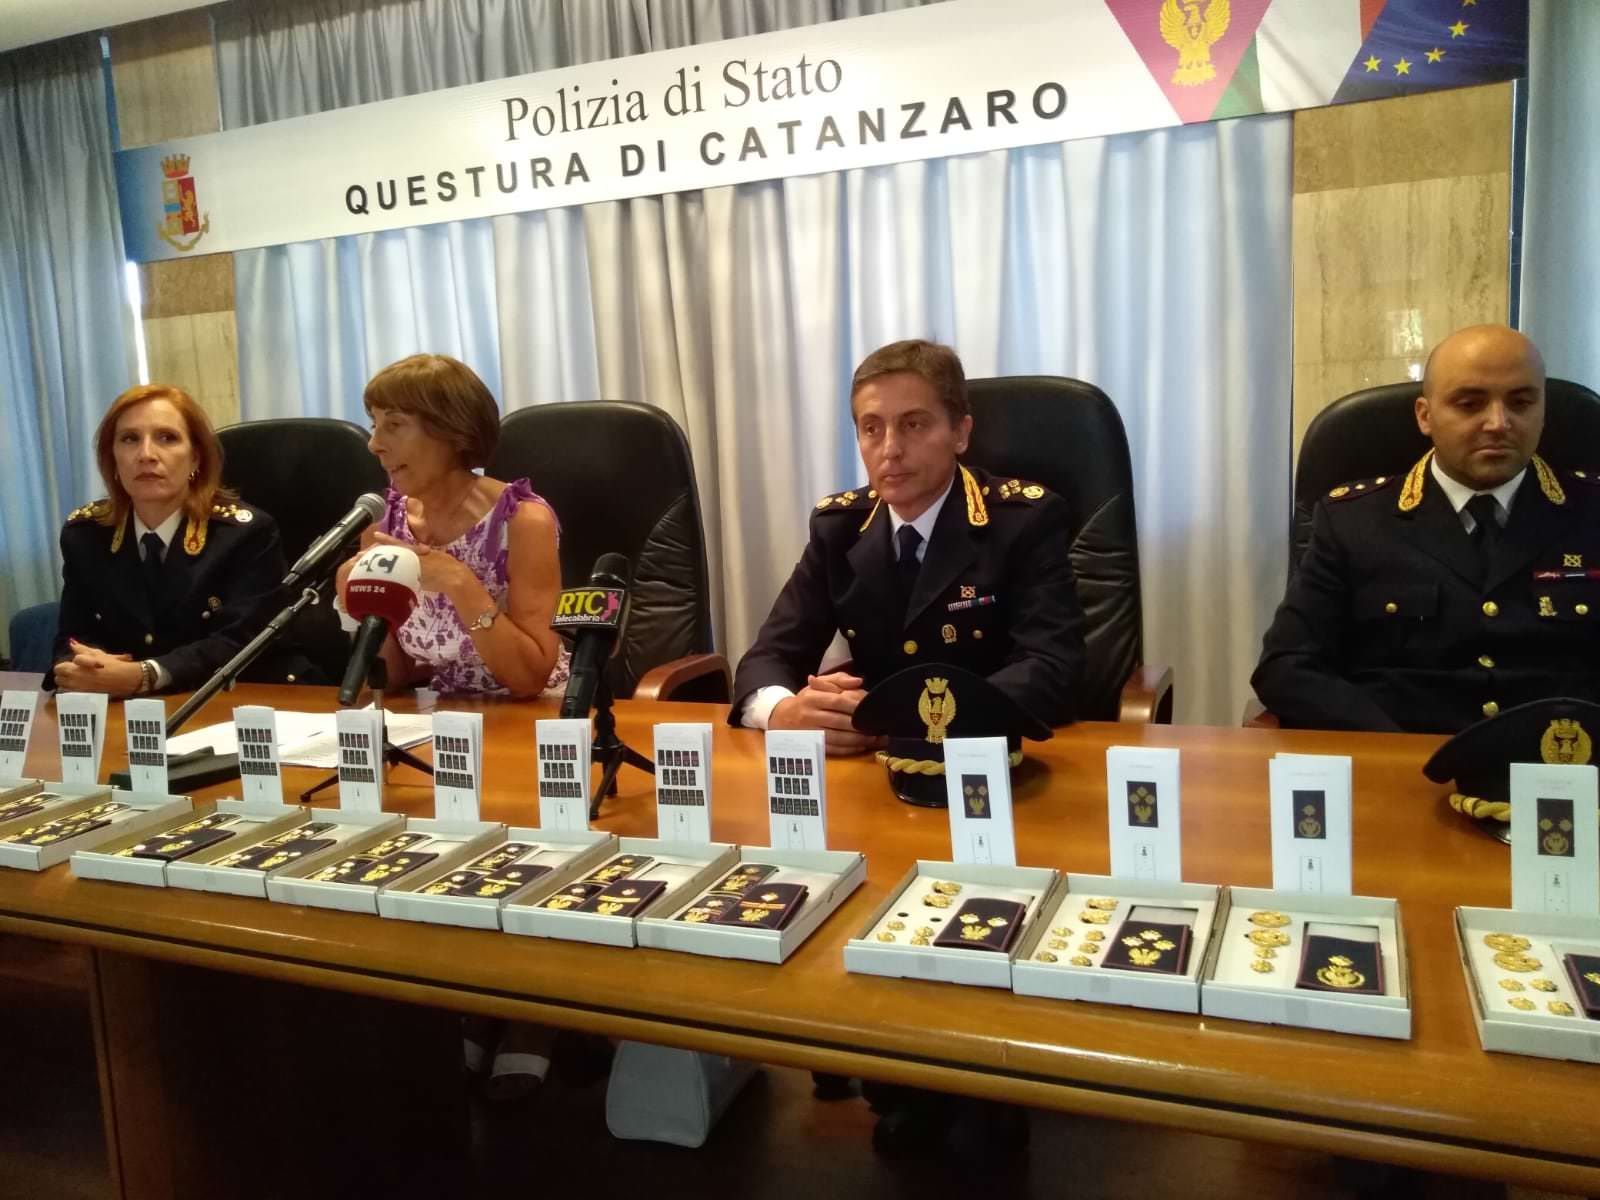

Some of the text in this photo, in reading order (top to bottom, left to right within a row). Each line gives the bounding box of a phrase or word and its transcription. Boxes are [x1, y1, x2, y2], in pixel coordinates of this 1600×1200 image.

[501, 53, 842, 141] Polizia di Stato
[345, 81, 1067, 215] QUESTURA DI CATANZARO
[350, 584, 386, 593] NEWS 24
[557, 591, 606, 615] RTC
